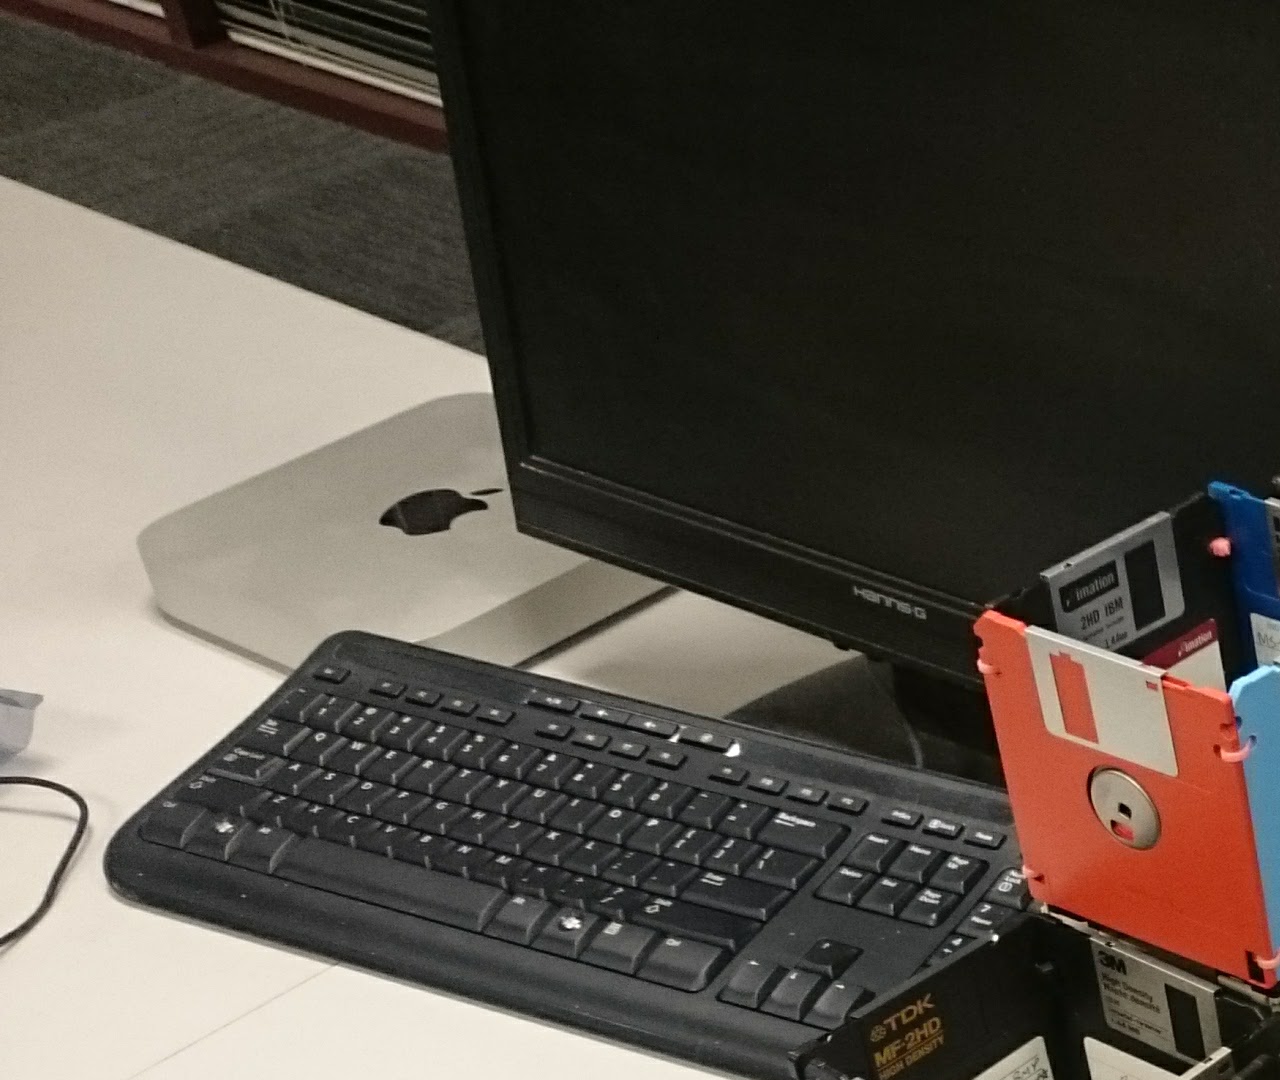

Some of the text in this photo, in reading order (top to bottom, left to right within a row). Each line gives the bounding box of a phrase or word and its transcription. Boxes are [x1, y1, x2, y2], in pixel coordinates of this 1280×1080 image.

[1076, 571, 1117, 602] imation
[1079, 609, 1101, 631] 2HD
[1104, 597, 1125, 618] IBM
[1184, 631, 1213, 653] imation
[1098, 950, 1127, 976] 3M
[883, 993, 936, 1031] TDK
[873, 1016, 942, 1067] MF-2HD
[905, 1034, 945, 1068] DENSITY
